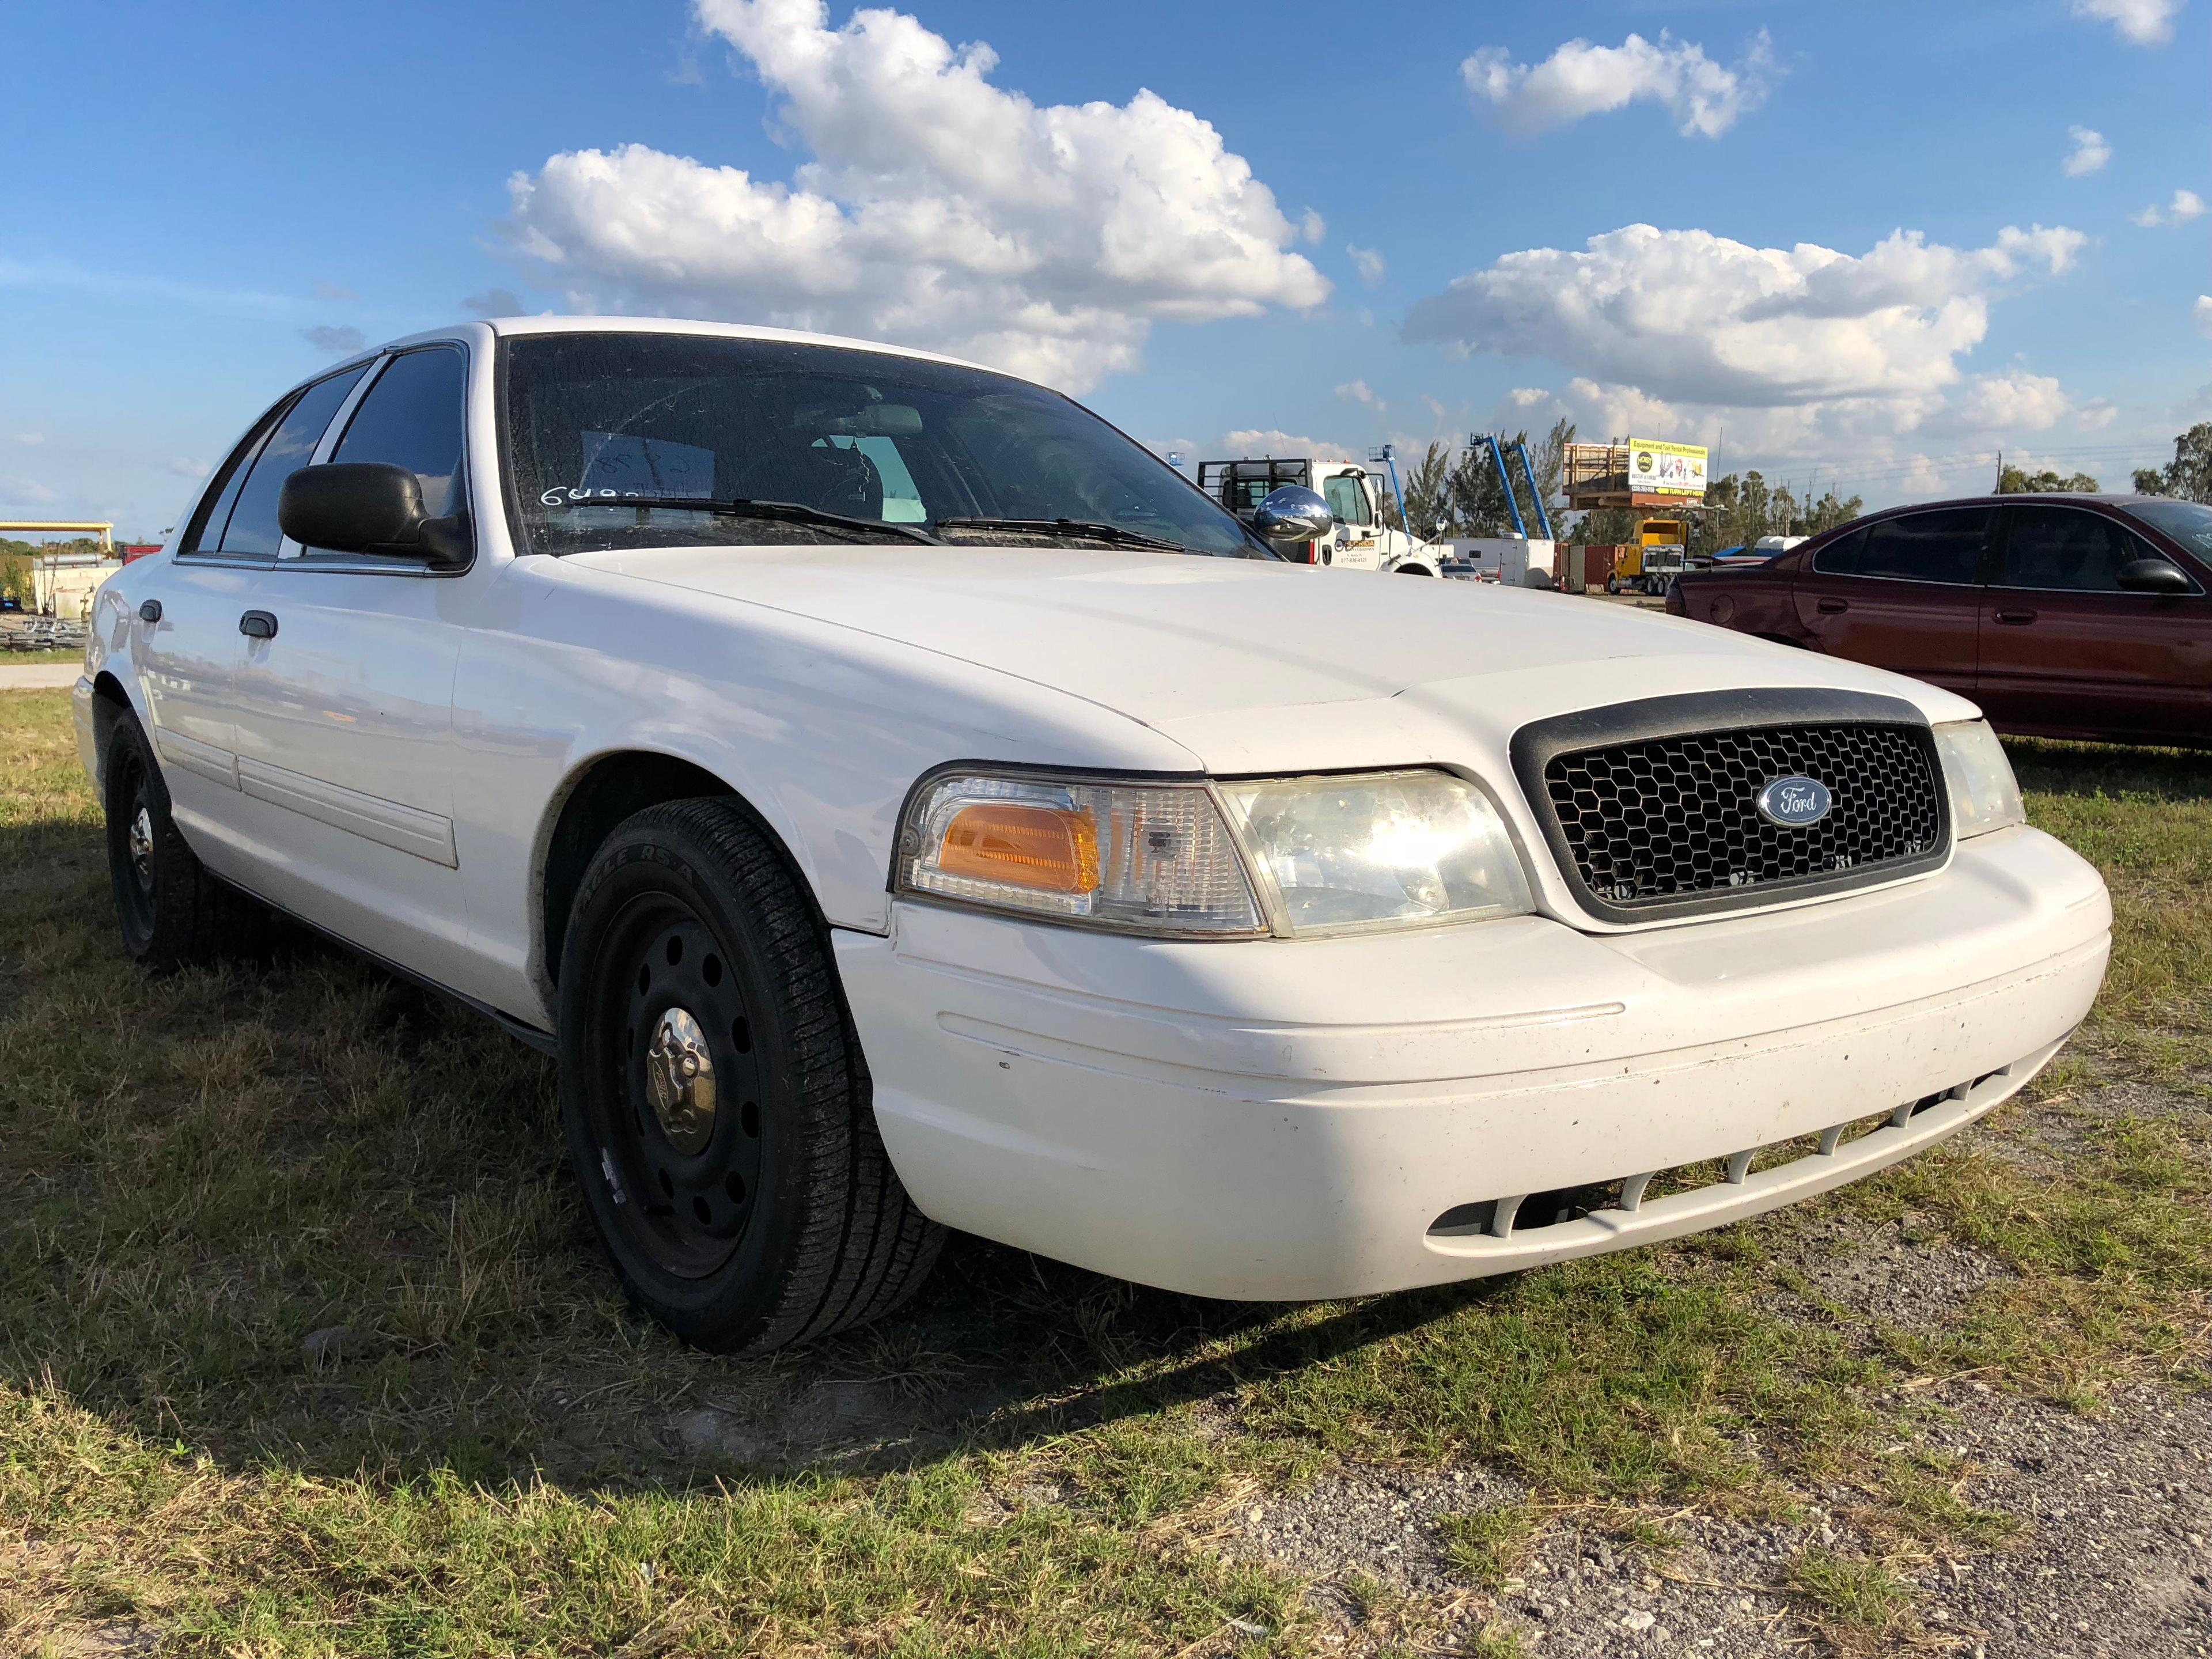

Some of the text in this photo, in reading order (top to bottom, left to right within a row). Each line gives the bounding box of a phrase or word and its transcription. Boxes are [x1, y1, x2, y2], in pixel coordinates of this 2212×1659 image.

[1634, 440, 1654, 449] Equipment
[1683, 446, 1705, 455] Professionals
[1638, 456, 1652, 466] HOIST
[1780, 787, 1817, 814] Ford
